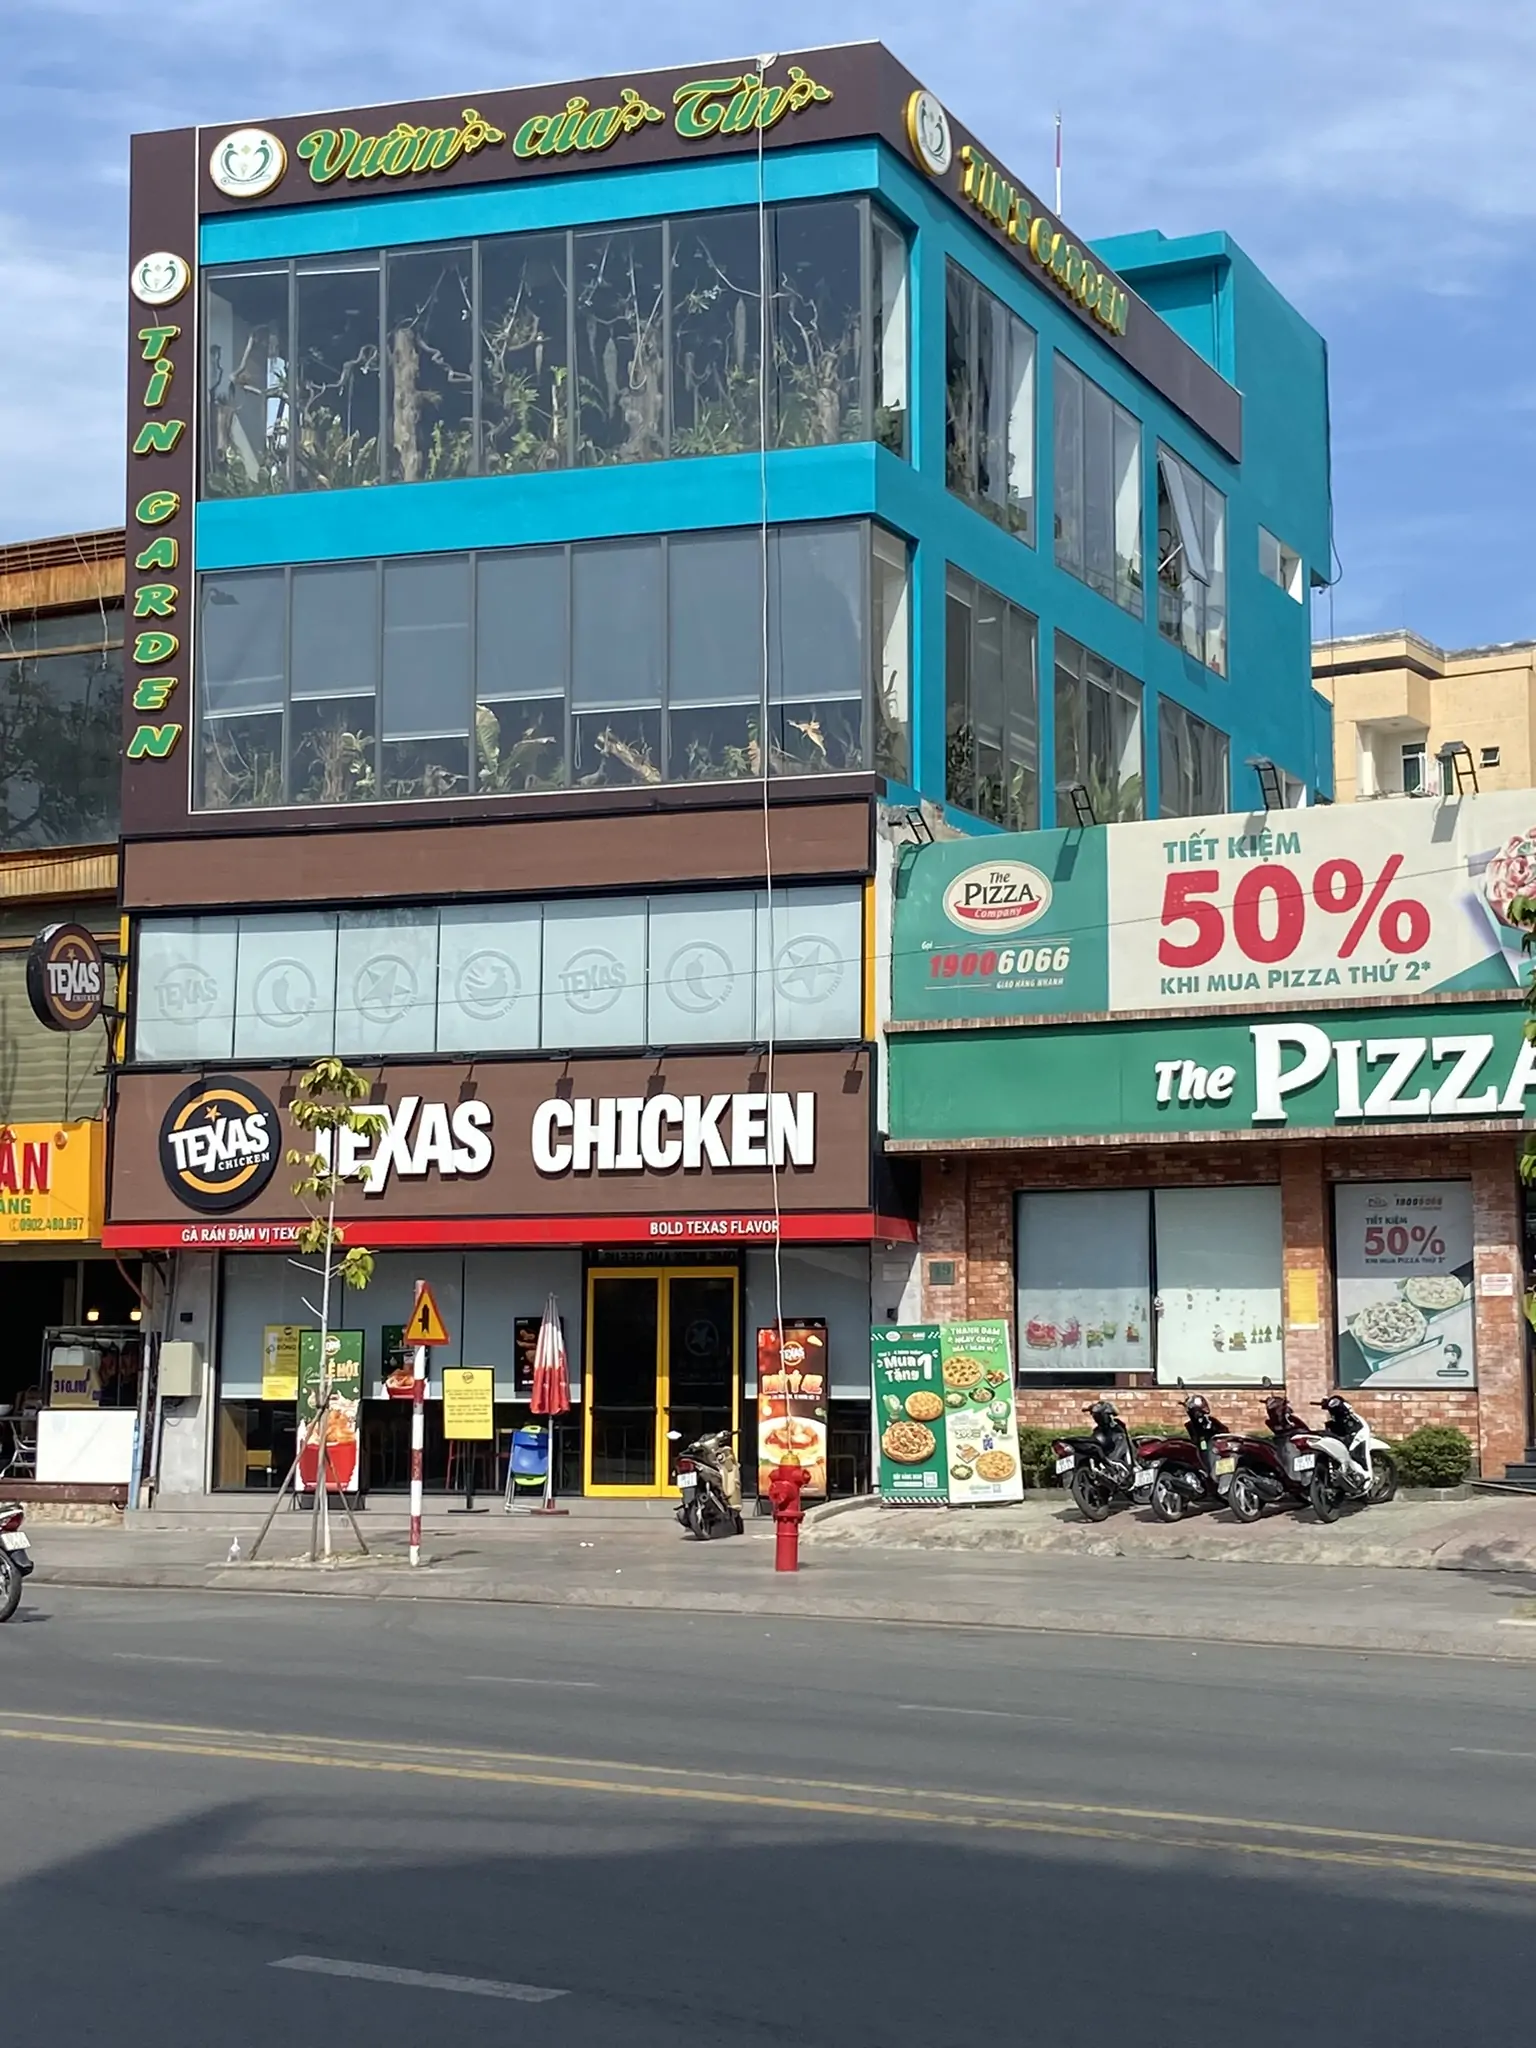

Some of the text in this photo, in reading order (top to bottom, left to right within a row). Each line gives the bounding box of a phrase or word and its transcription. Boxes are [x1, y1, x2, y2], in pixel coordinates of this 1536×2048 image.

[513, 88, 664, 158] của
[1030, 217, 1129, 337] GARDEN
[127, 490, 182, 760] GARDEN
[1163, 827, 1301, 864] TIẾT KIỆM
[964, 883, 1035, 906] PIZZA
[989, 872, 1011, 884] The
[974, 906, 1023, 920] Company
[1158, 854, 1431, 968] 50%
[47, 960, 100, 1002] TEXAS
[558, 962, 627, 999] TEXAS
[1160, 976, 1200, 995] KHI
[1207, 973, 1261, 992] MUA
[1267, 967, 1341, 989] PIZZA
[1347, 958, 1398, 983] THỨ
[1155, 1058, 1237, 1103] The
[168, 1114, 270, 1174] TEXAS
[531, 1091, 815, 1173] CHICKEN
[218, 1152, 270, 1171] CHICKEN
[181, 1225, 199, 1242] GÀ
[201, 1225, 226, 1241] RÁN
[228, 1225, 255, 1243] ĐẬM
[258, 1227, 270, 1243] VỊ
[650, 1222, 683, 1235] BOLD
[687, 1221, 727, 1234] TEXAS
[1365, 1225, 1446, 1256] 50%
[883, 1355, 916, 1369] Mua
